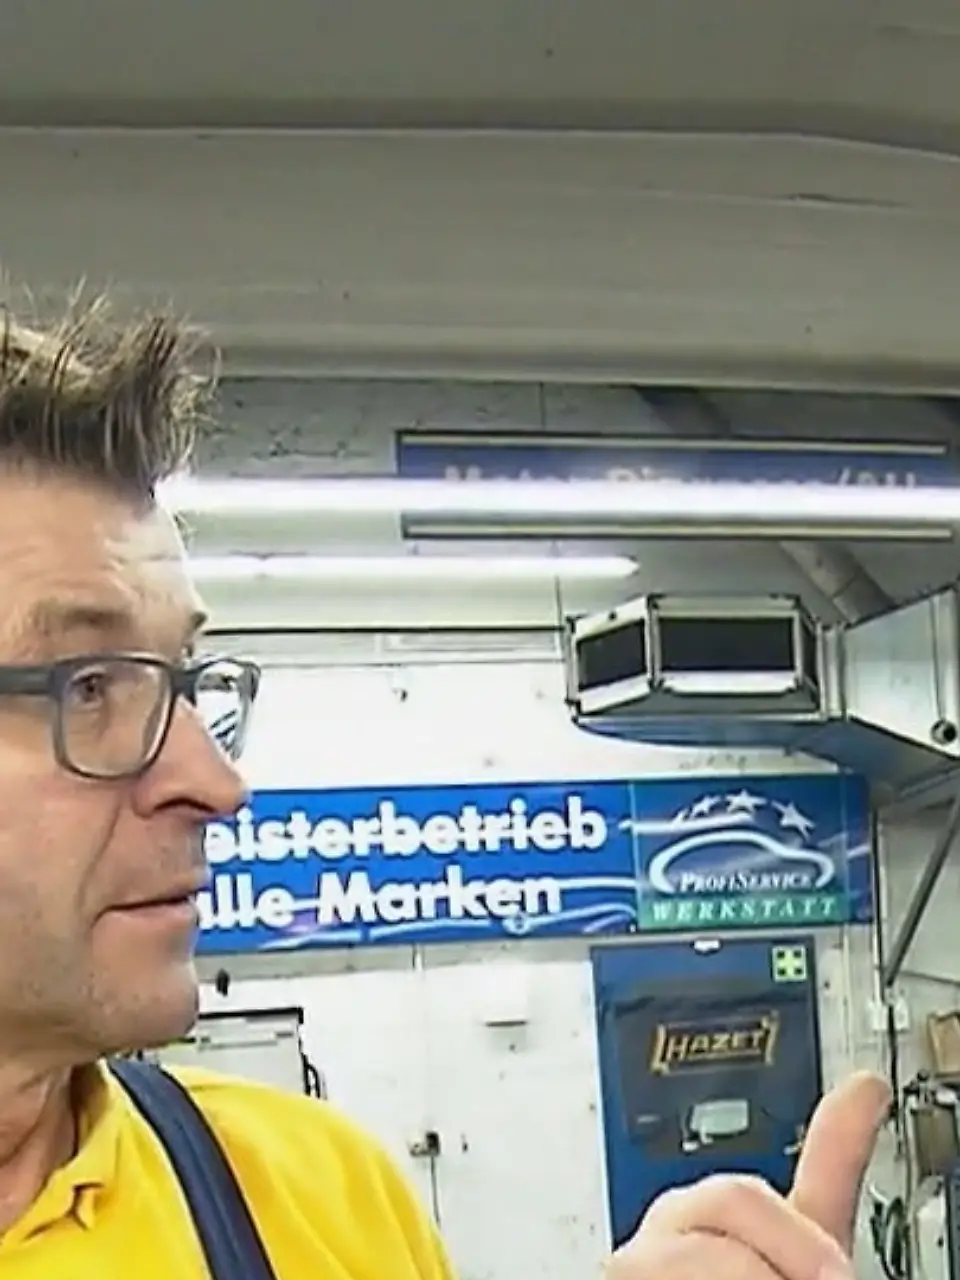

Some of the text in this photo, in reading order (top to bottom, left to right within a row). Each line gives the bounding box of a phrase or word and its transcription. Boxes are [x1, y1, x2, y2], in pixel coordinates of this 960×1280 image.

[204, 796, 608, 865] eisterbetrieb
[317, 865, 562, 925] Marken
[651, 896, 838, 923] WERKSTATT
[664, 1027, 768, 1061] HAZET
